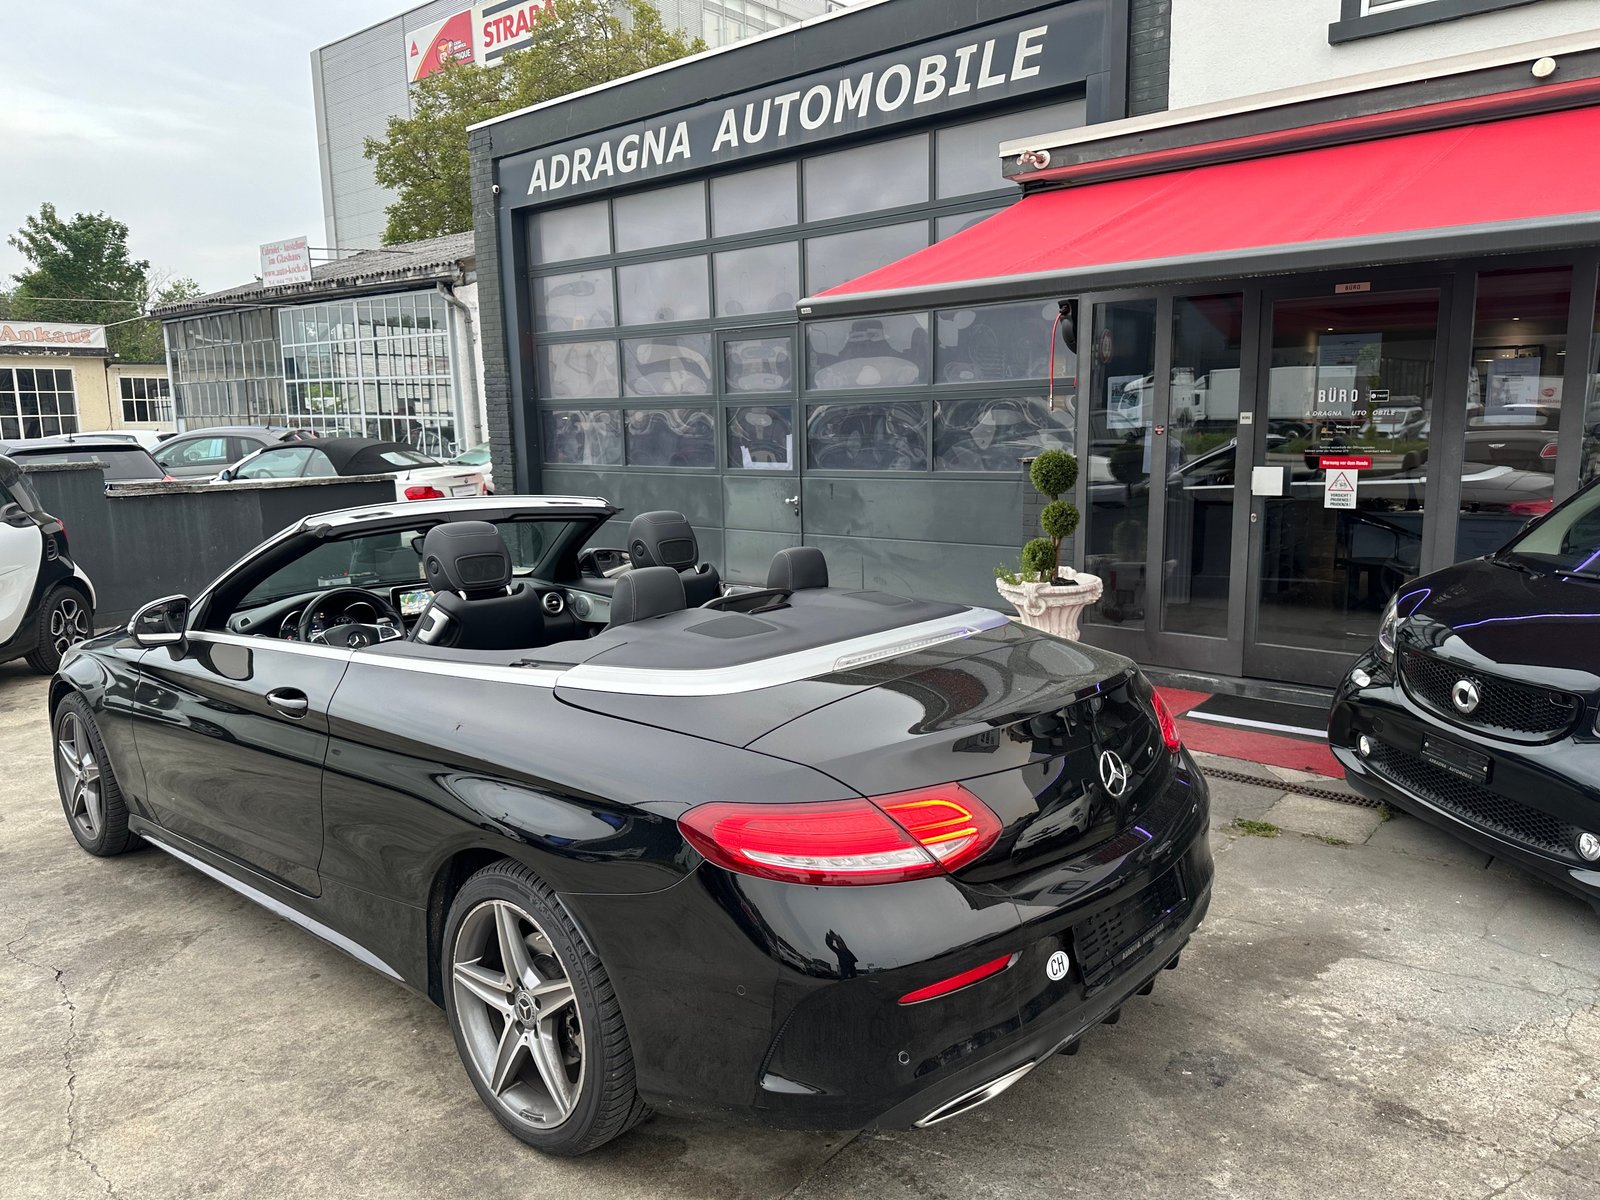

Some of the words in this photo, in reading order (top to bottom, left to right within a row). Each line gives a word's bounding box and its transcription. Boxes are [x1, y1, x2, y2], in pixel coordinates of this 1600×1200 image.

[527, 121, 692, 195] ADRAGNA
[711, 25, 1048, 152] AUTOMOBILE
[0, 324, 91, 343] Ankauf
[1318, 387, 1359, 403] BÜRO
[565, 946, 590, 999] POLARIS
[1050, 955, 1066, 977] CH
